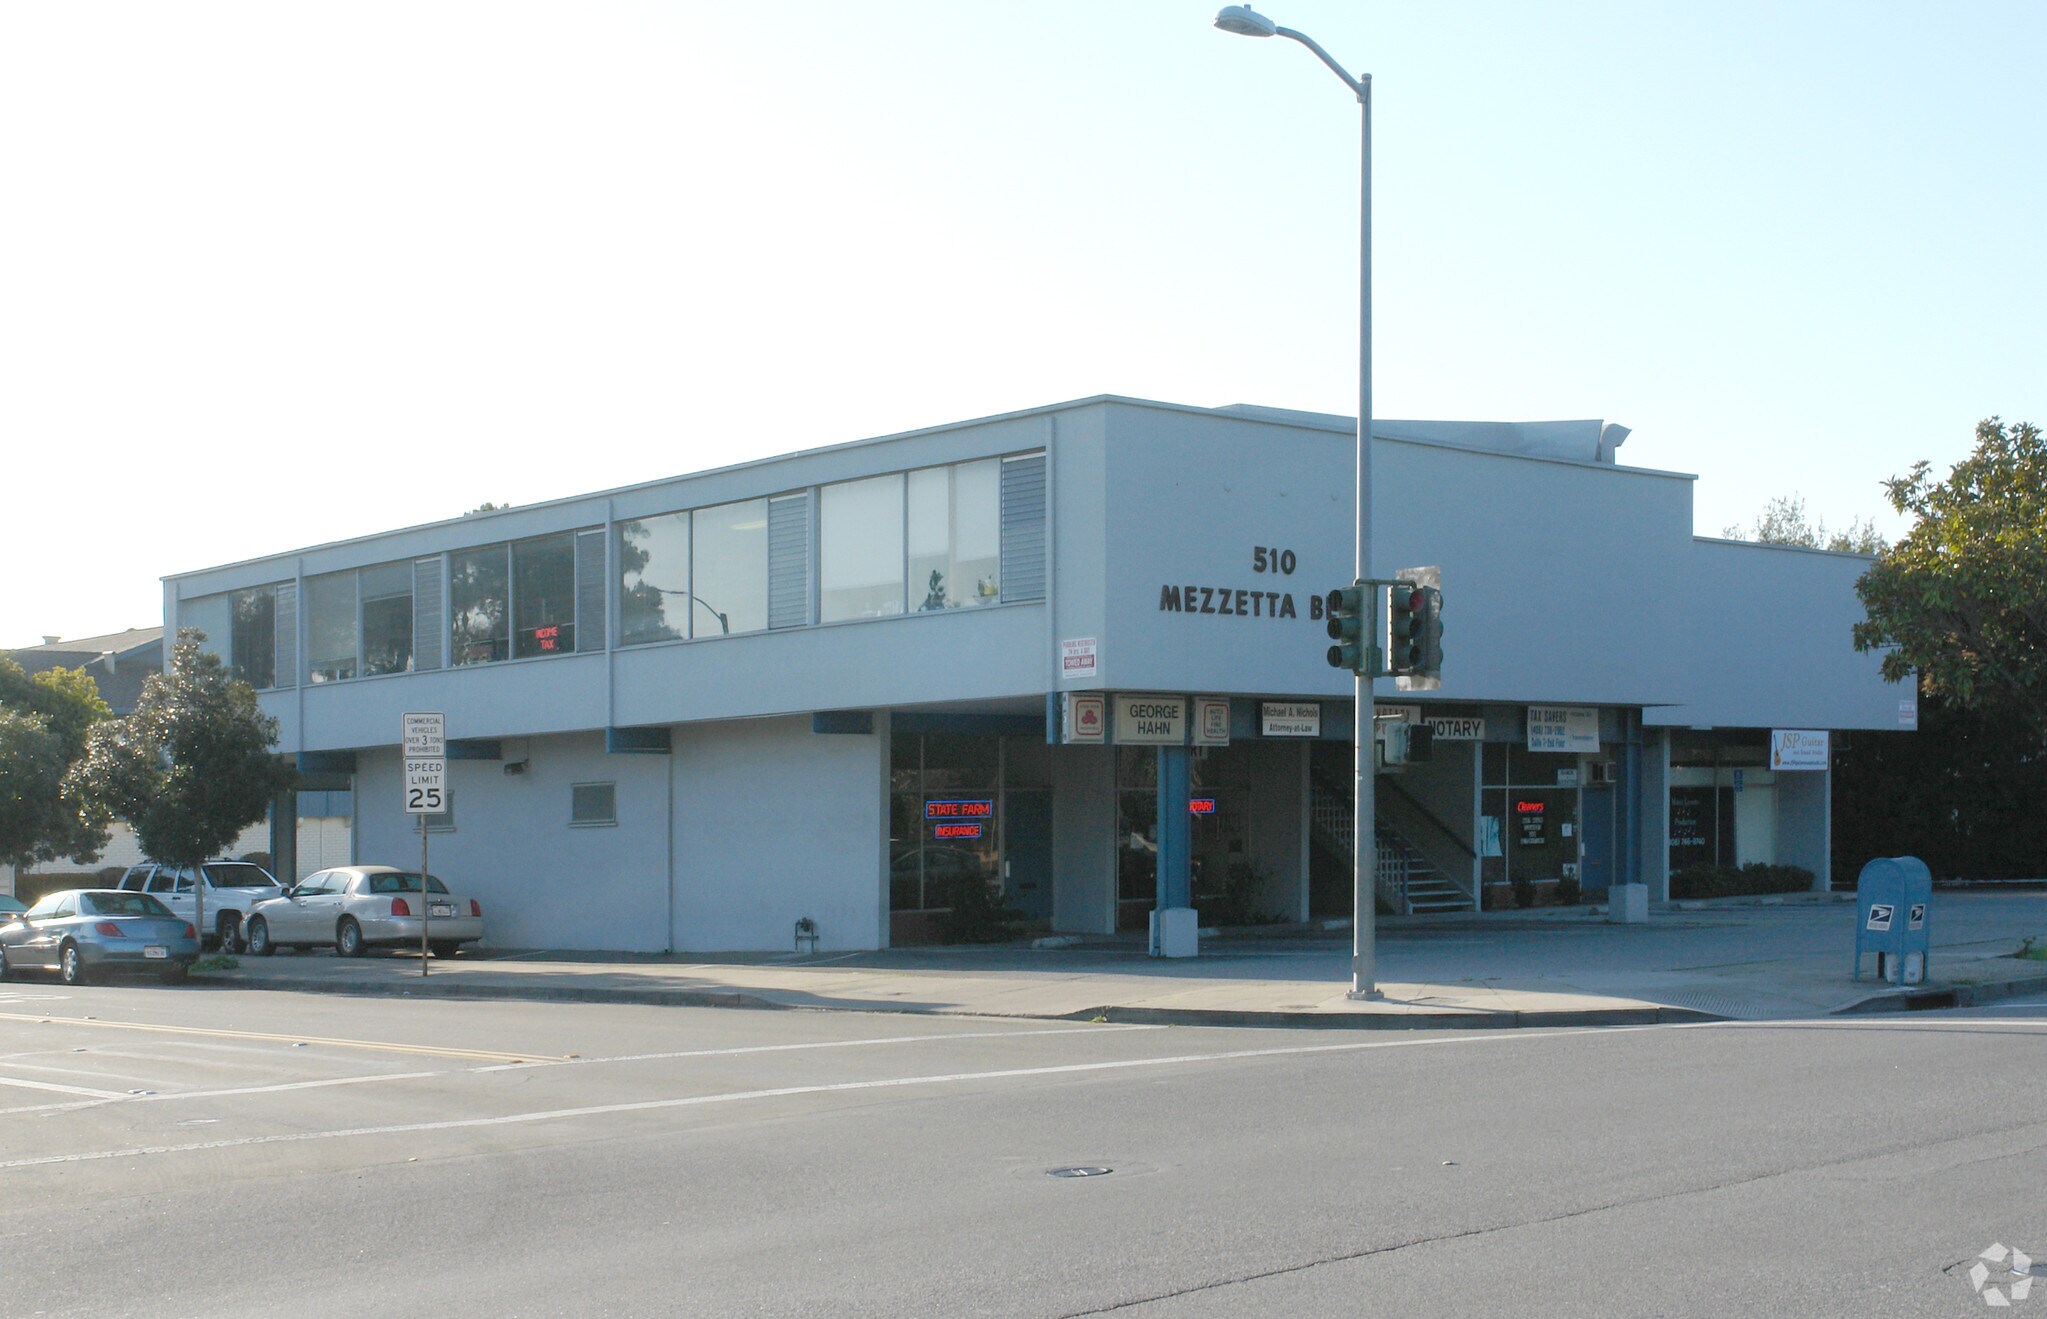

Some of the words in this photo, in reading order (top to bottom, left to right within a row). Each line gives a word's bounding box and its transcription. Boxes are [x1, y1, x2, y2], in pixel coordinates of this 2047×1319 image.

[1252, 546, 1296, 575] 510
[1159, 585, 1297, 619] MEZZETTA
[540, 639, 554, 650] TAX
[1129, 704, 1179, 719] GEORGE
[1263, 706, 1286, 717] Michael
[1296, 707, 1318, 718] Nichols
[1544, 709, 1567, 723] SAVERS
[1137, 721, 1171, 735] HAHN
[1269, 723, 1312, 733] Attorney-at-Law
[421, 735, 428, 746] 3
[1781, 732, 1800, 751] JSP
[1801, 736, 1824, 747] Guitar
[407, 763, 443, 772] SPEED
[411, 776, 439, 785] LIMIT
[409, 788, 441, 809] 25
[928, 803, 958, 816] STATE
[961, 803, 990, 816] FARM
[937, 826, 979, 837] INSURANCE
